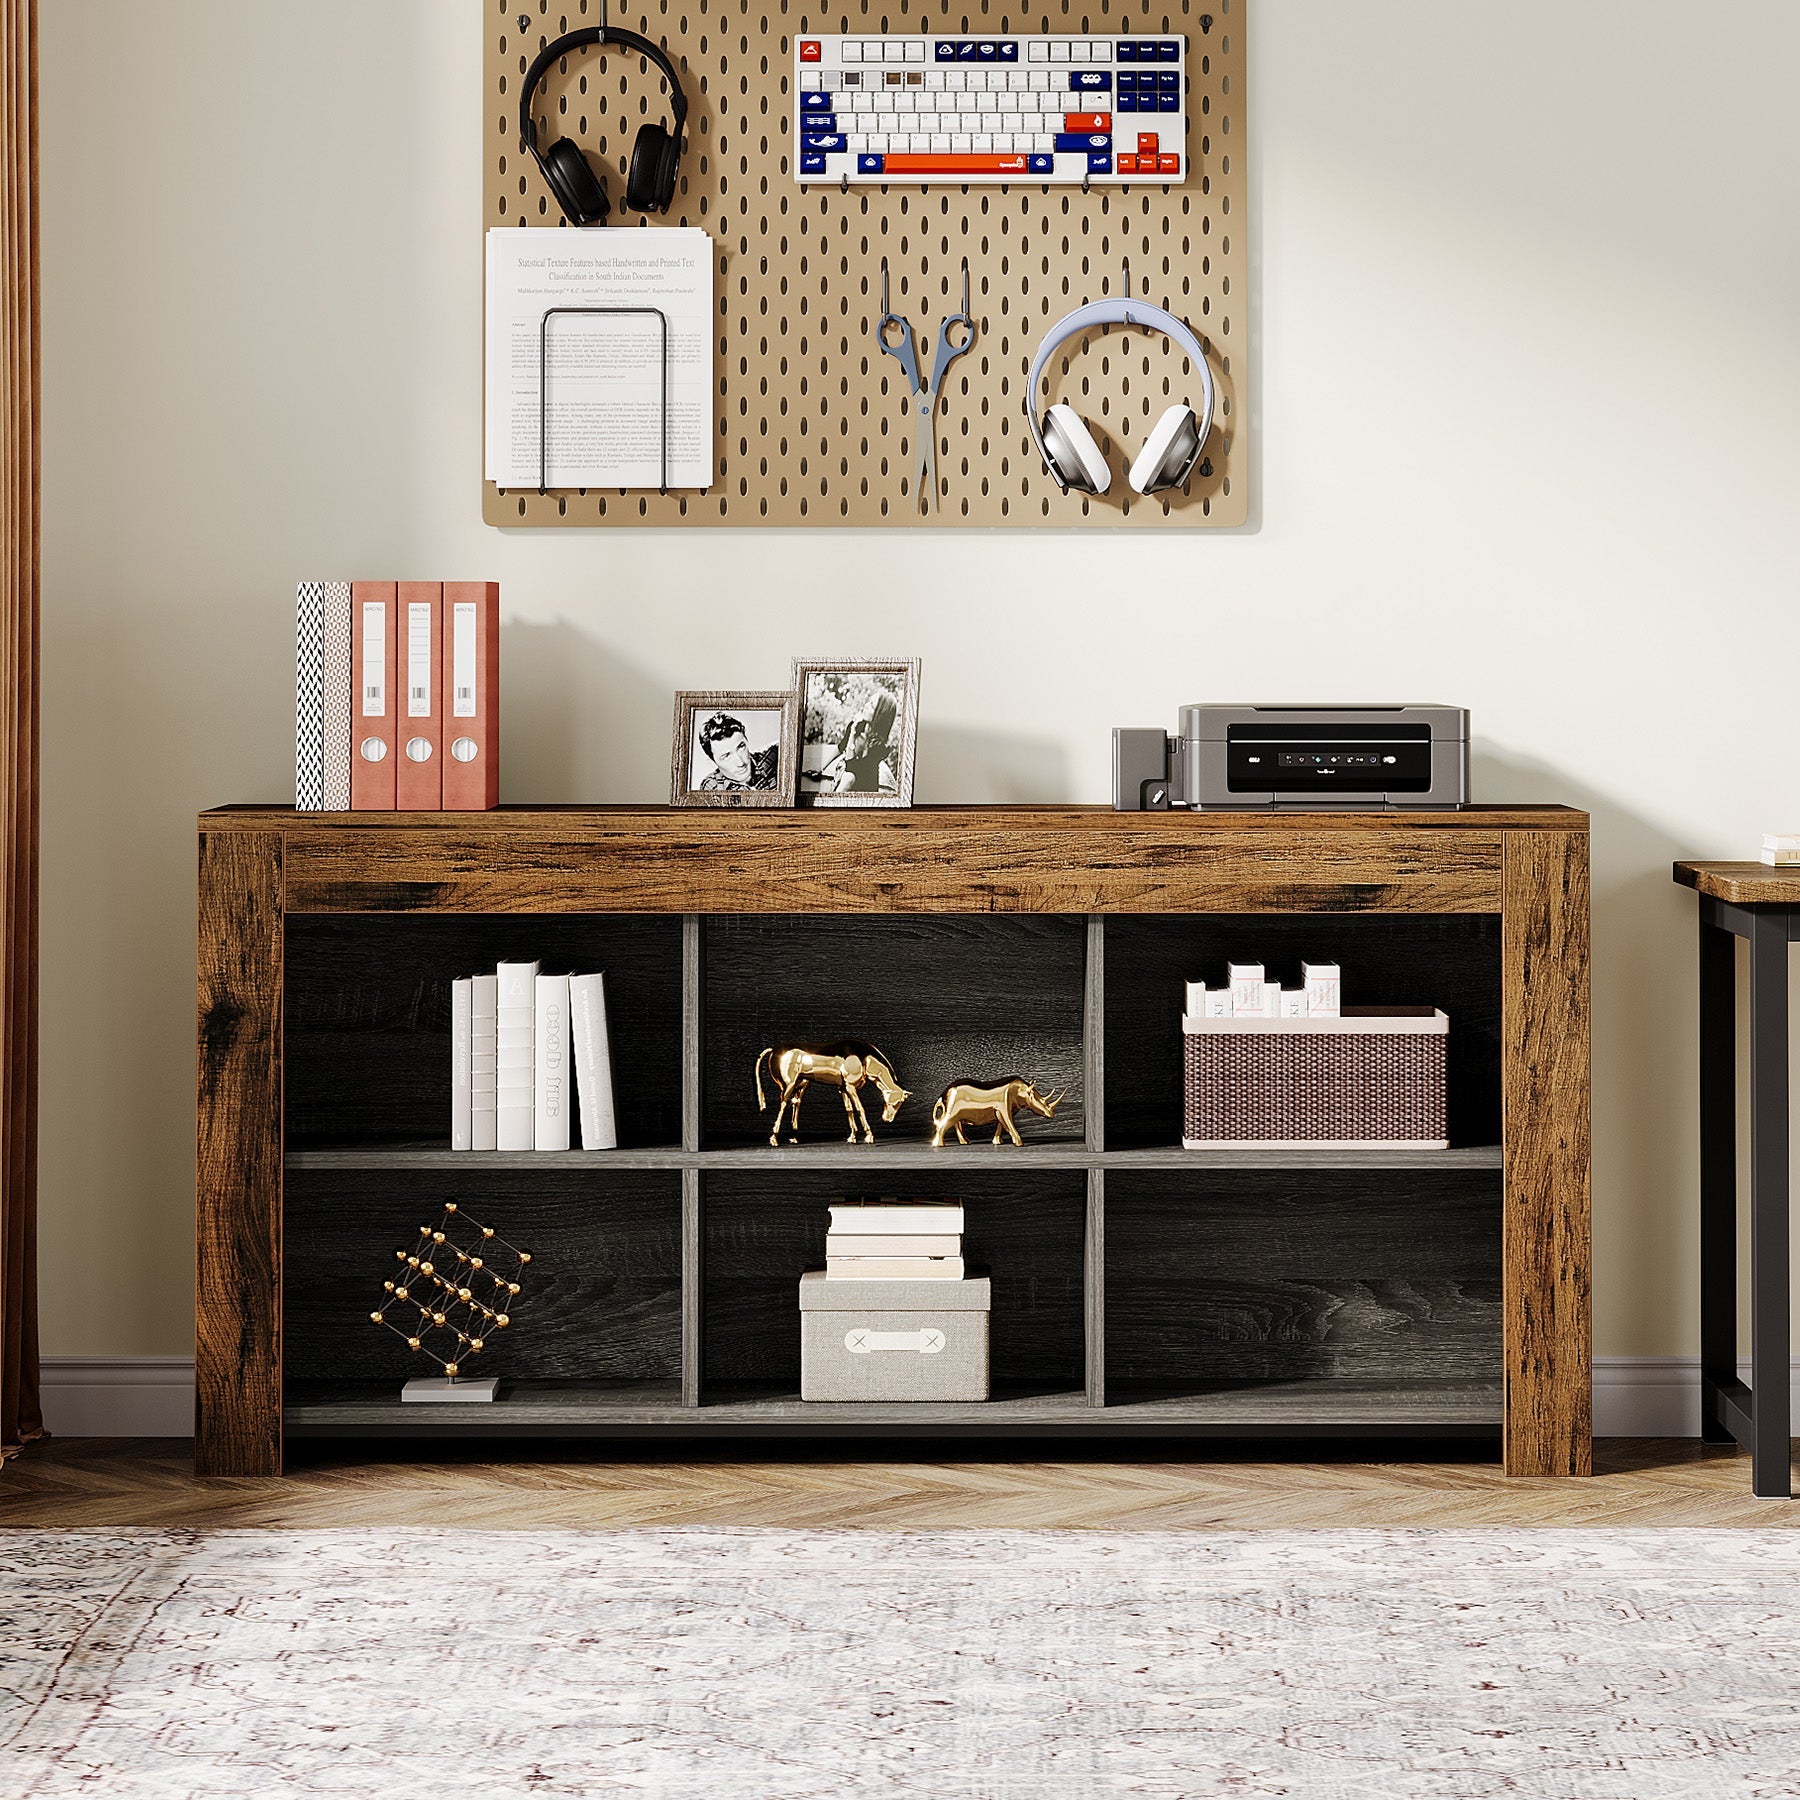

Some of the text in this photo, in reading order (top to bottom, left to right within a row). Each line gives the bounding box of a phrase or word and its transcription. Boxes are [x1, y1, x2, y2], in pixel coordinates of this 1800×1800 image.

[518, 257, 695, 268] Statistical Texture Features based Handwritten and Printed Text
[548, 271, 665, 281] Classification in South Indian Documents
